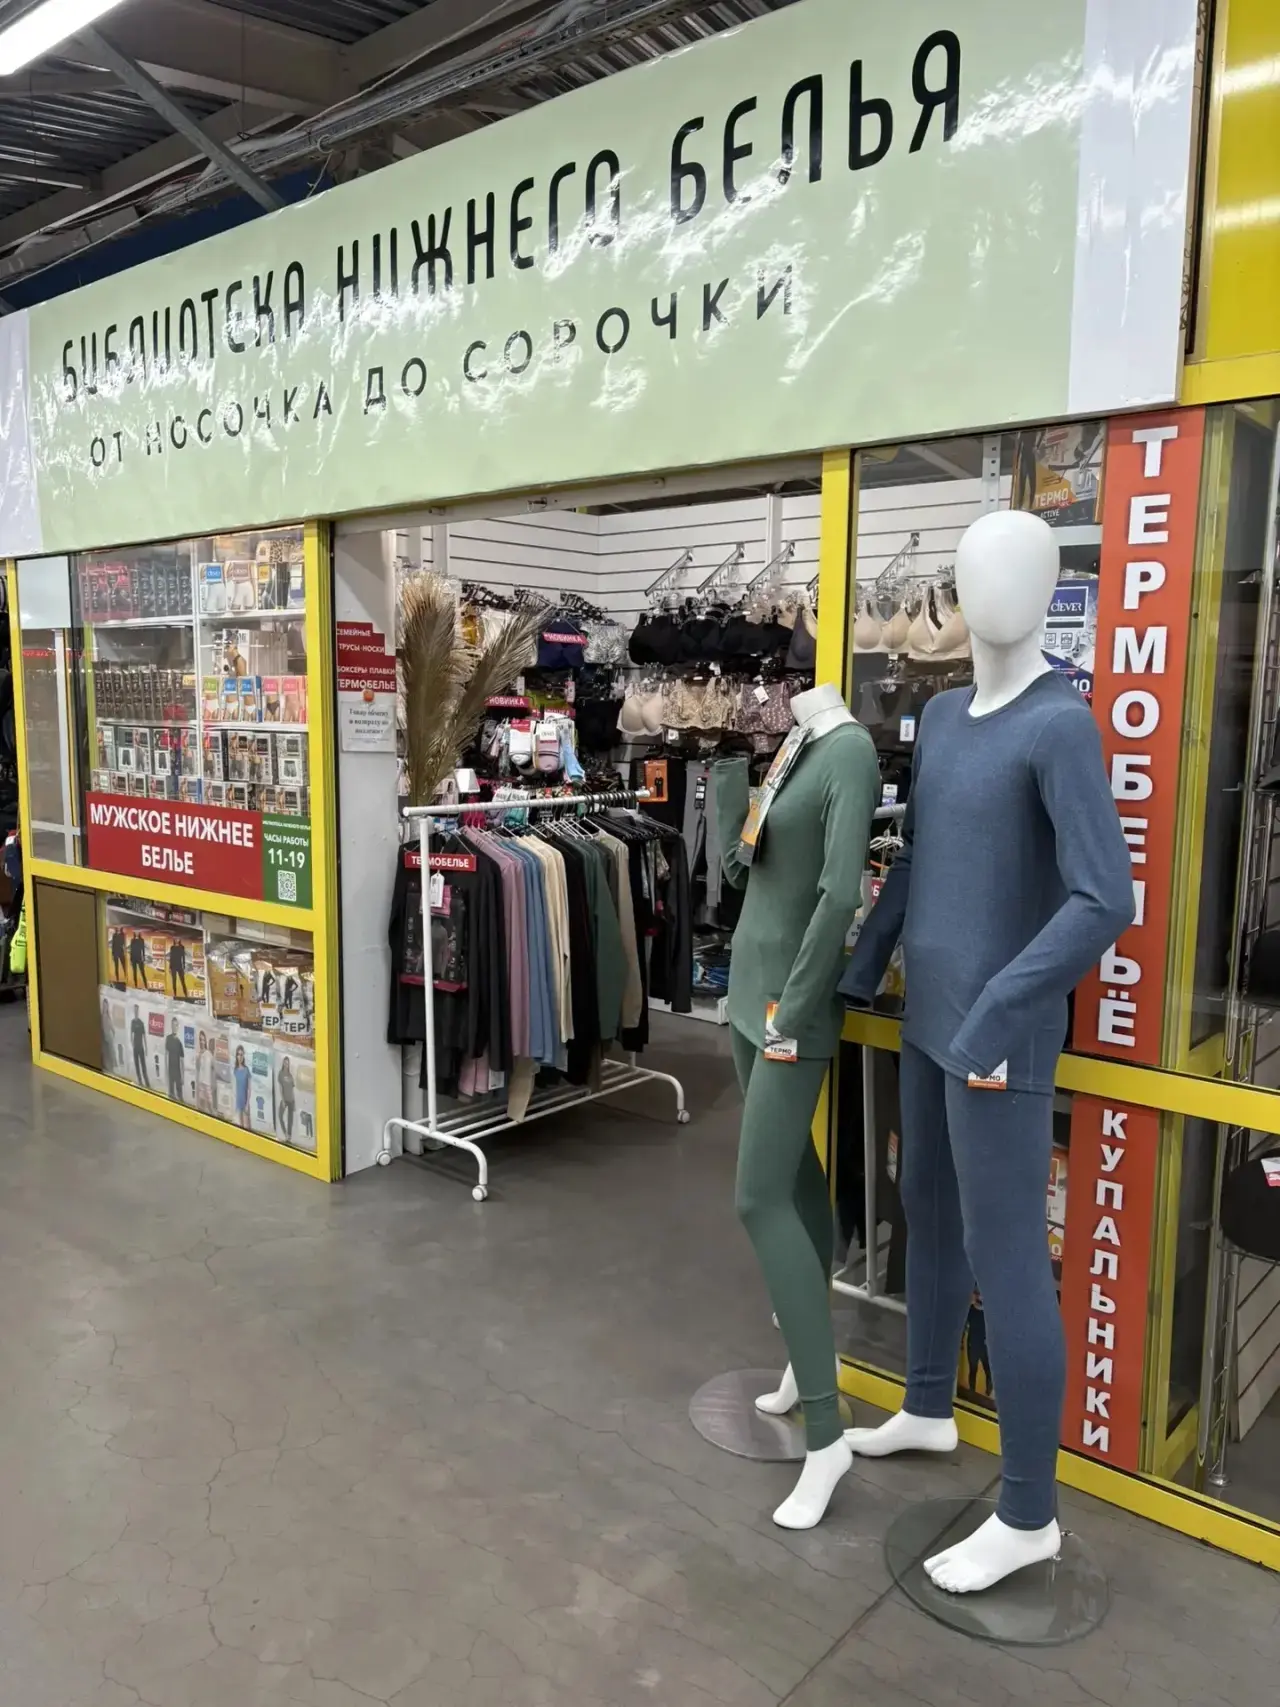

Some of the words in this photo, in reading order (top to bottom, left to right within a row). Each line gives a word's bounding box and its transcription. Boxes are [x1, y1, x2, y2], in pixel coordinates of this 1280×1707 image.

[62, 261, 305, 403] БИБЛИОТЕКА
[337, 149, 620, 322] НИЖНЕГО
[670, 29, 961, 226] БЕЛЬЯ
[90, 431, 122, 467] ОТ
[146, 381, 333, 455] НОСОЧКА
[364, 357, 427, 415] ДО
[463, 264, 793, 383] СОРОЧКИ
[1034, 487, 1069, 508] ТЕРМО
[338, 643, 361, 652] ТРУСЫ
[362, 645, 385, 653] НОСКИ
[369, 667, 395, 675] ПЛАВКИ
[489, 696, 525, 706] НОВИНКА
[90, 803, 172, 835] МУЖСКОЕ
[174, 813, 254, 848] НИЖНЕЕ
[264, 833, 282, 843] ЧАСЫ
[283, 835, 310, 847] РАБОТЫ
[141, 844, 194, 875] БЕЛЬЕ
[268, 847, 305, 868] 11-19
[411, 856, 470, 868] ТЕМОБЕЛЬЕ
[770, 1046, 792, 1054] ТЕРМО
[1081, 1108, 1128, 1453] КУПАЛЬНИКИ
